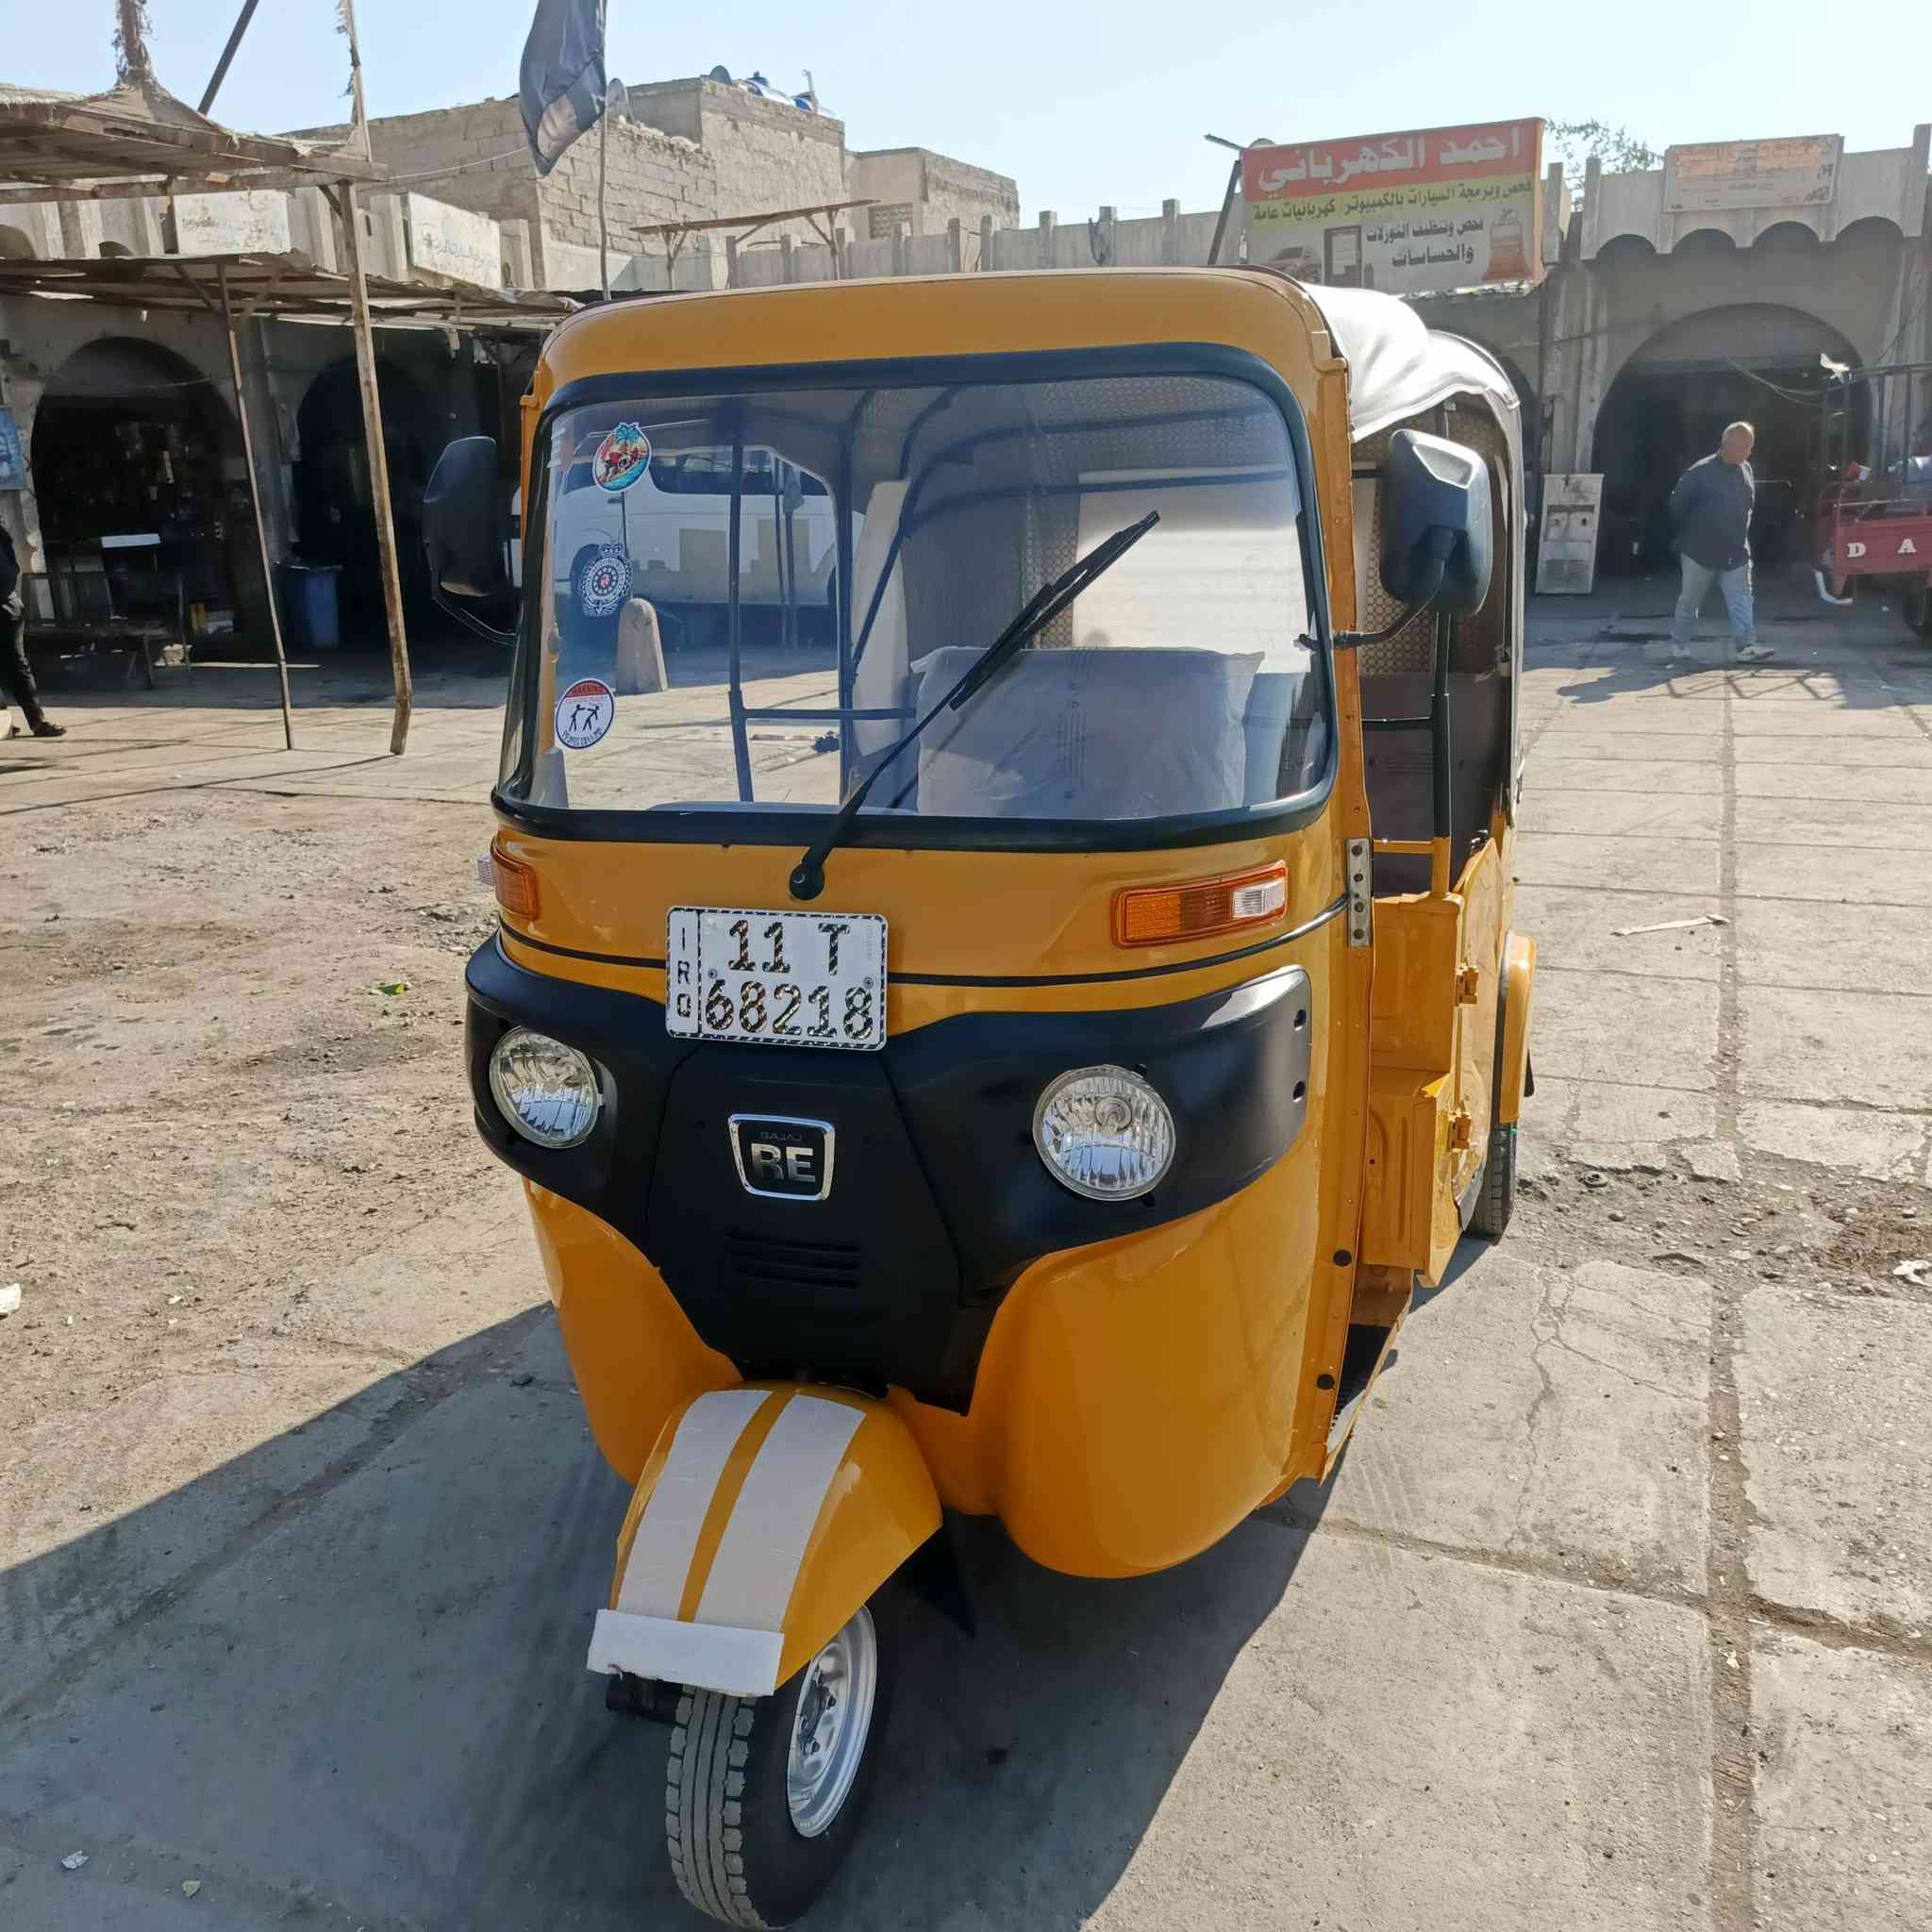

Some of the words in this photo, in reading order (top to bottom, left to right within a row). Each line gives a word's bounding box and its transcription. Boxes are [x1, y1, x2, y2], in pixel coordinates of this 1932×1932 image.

[1440, 125, 1521, 164] احمد
[1344, 191, 1404, 215] بالكمبيوتر
[1407, 187, 1456, 207] السيارات
[1458, 183, 1500, 202] وبرمجة
[1253, 203, 1278, 220] عامة
[1391, 242, 1474, 267] والحساسات
[727, 919, 791, 974] 11
[818, 923, 851, 976] T
[705, 978, 874, 1041] 68218
[751, 1142, 816, 1183] RE
